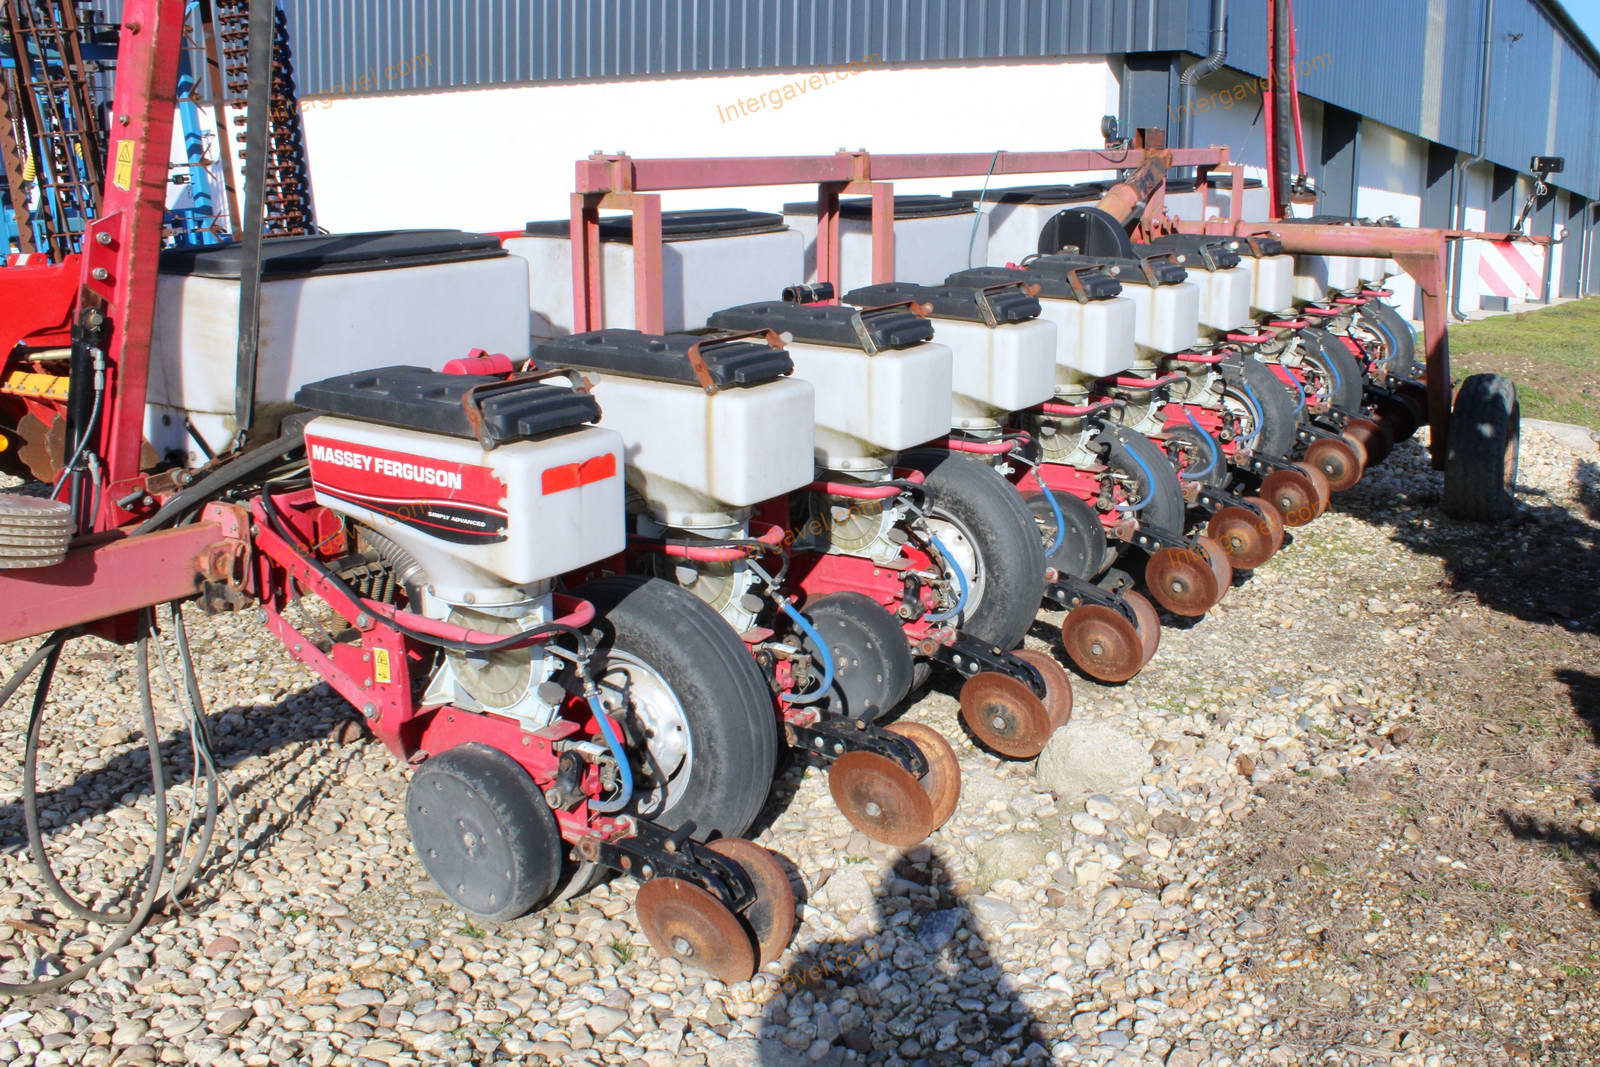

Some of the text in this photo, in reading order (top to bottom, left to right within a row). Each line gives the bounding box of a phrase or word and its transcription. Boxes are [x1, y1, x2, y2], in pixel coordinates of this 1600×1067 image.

[311, 444, 463, 490] MASSEY FERGUSON
[427, 510, 487, 529] SIMPLY ADVANCED
